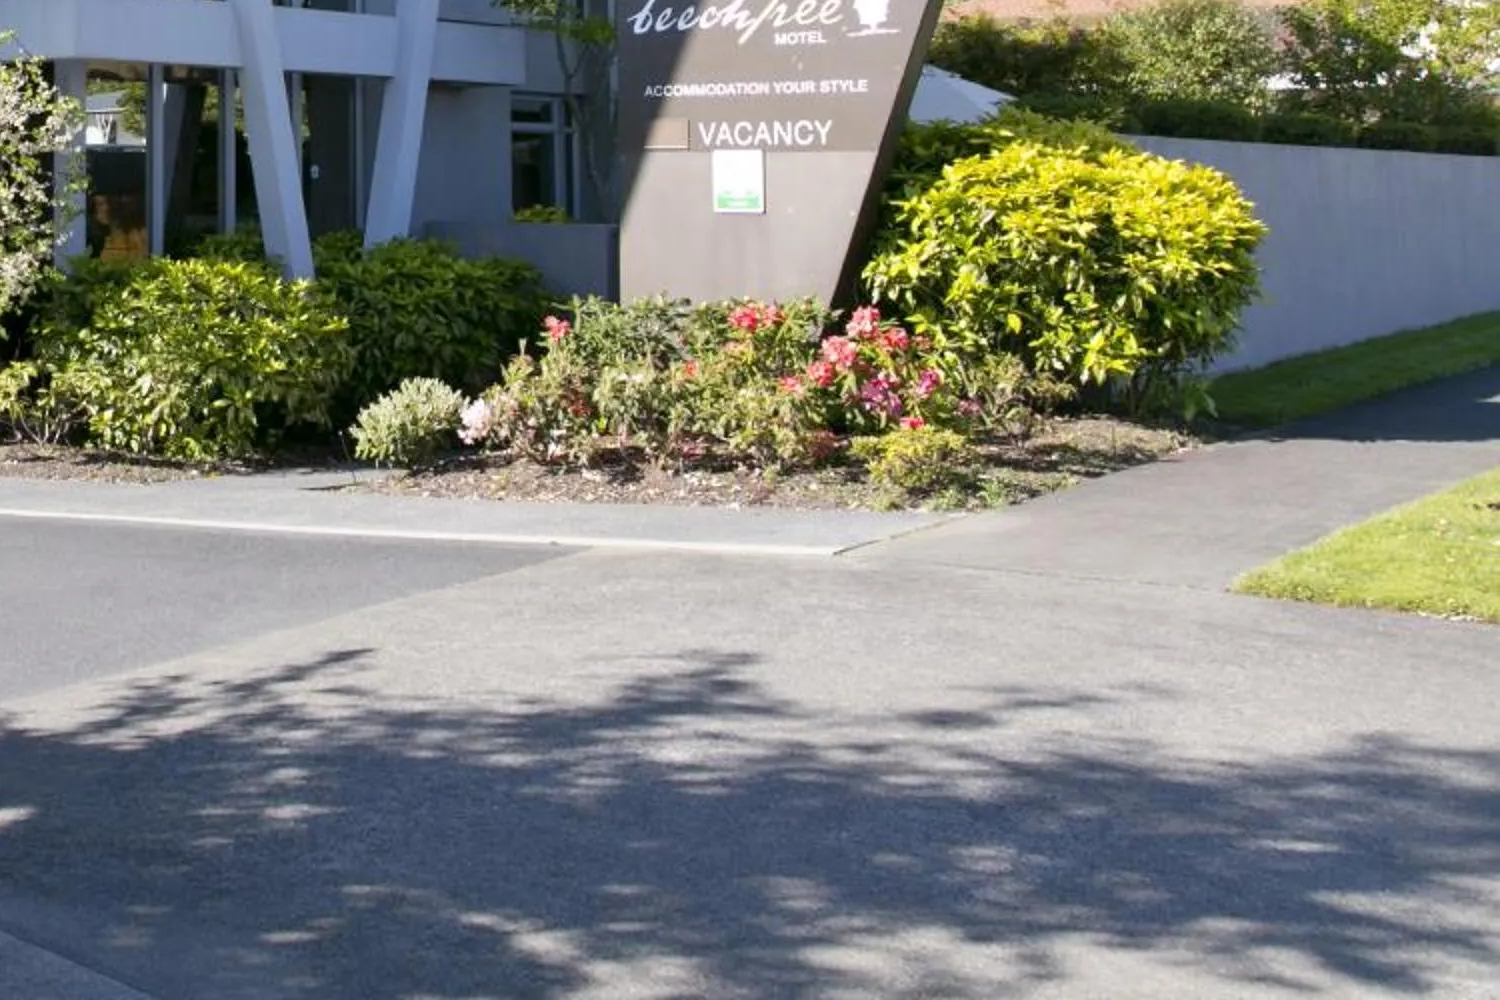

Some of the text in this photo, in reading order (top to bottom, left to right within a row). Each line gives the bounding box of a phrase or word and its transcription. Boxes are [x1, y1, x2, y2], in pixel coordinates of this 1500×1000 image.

[774, 31, 827, 46] MOTEL
[644, 79, 869, 98] ACCOMMODATION YOUR STYLE
[698, 119, 833, 147] VACANCY
